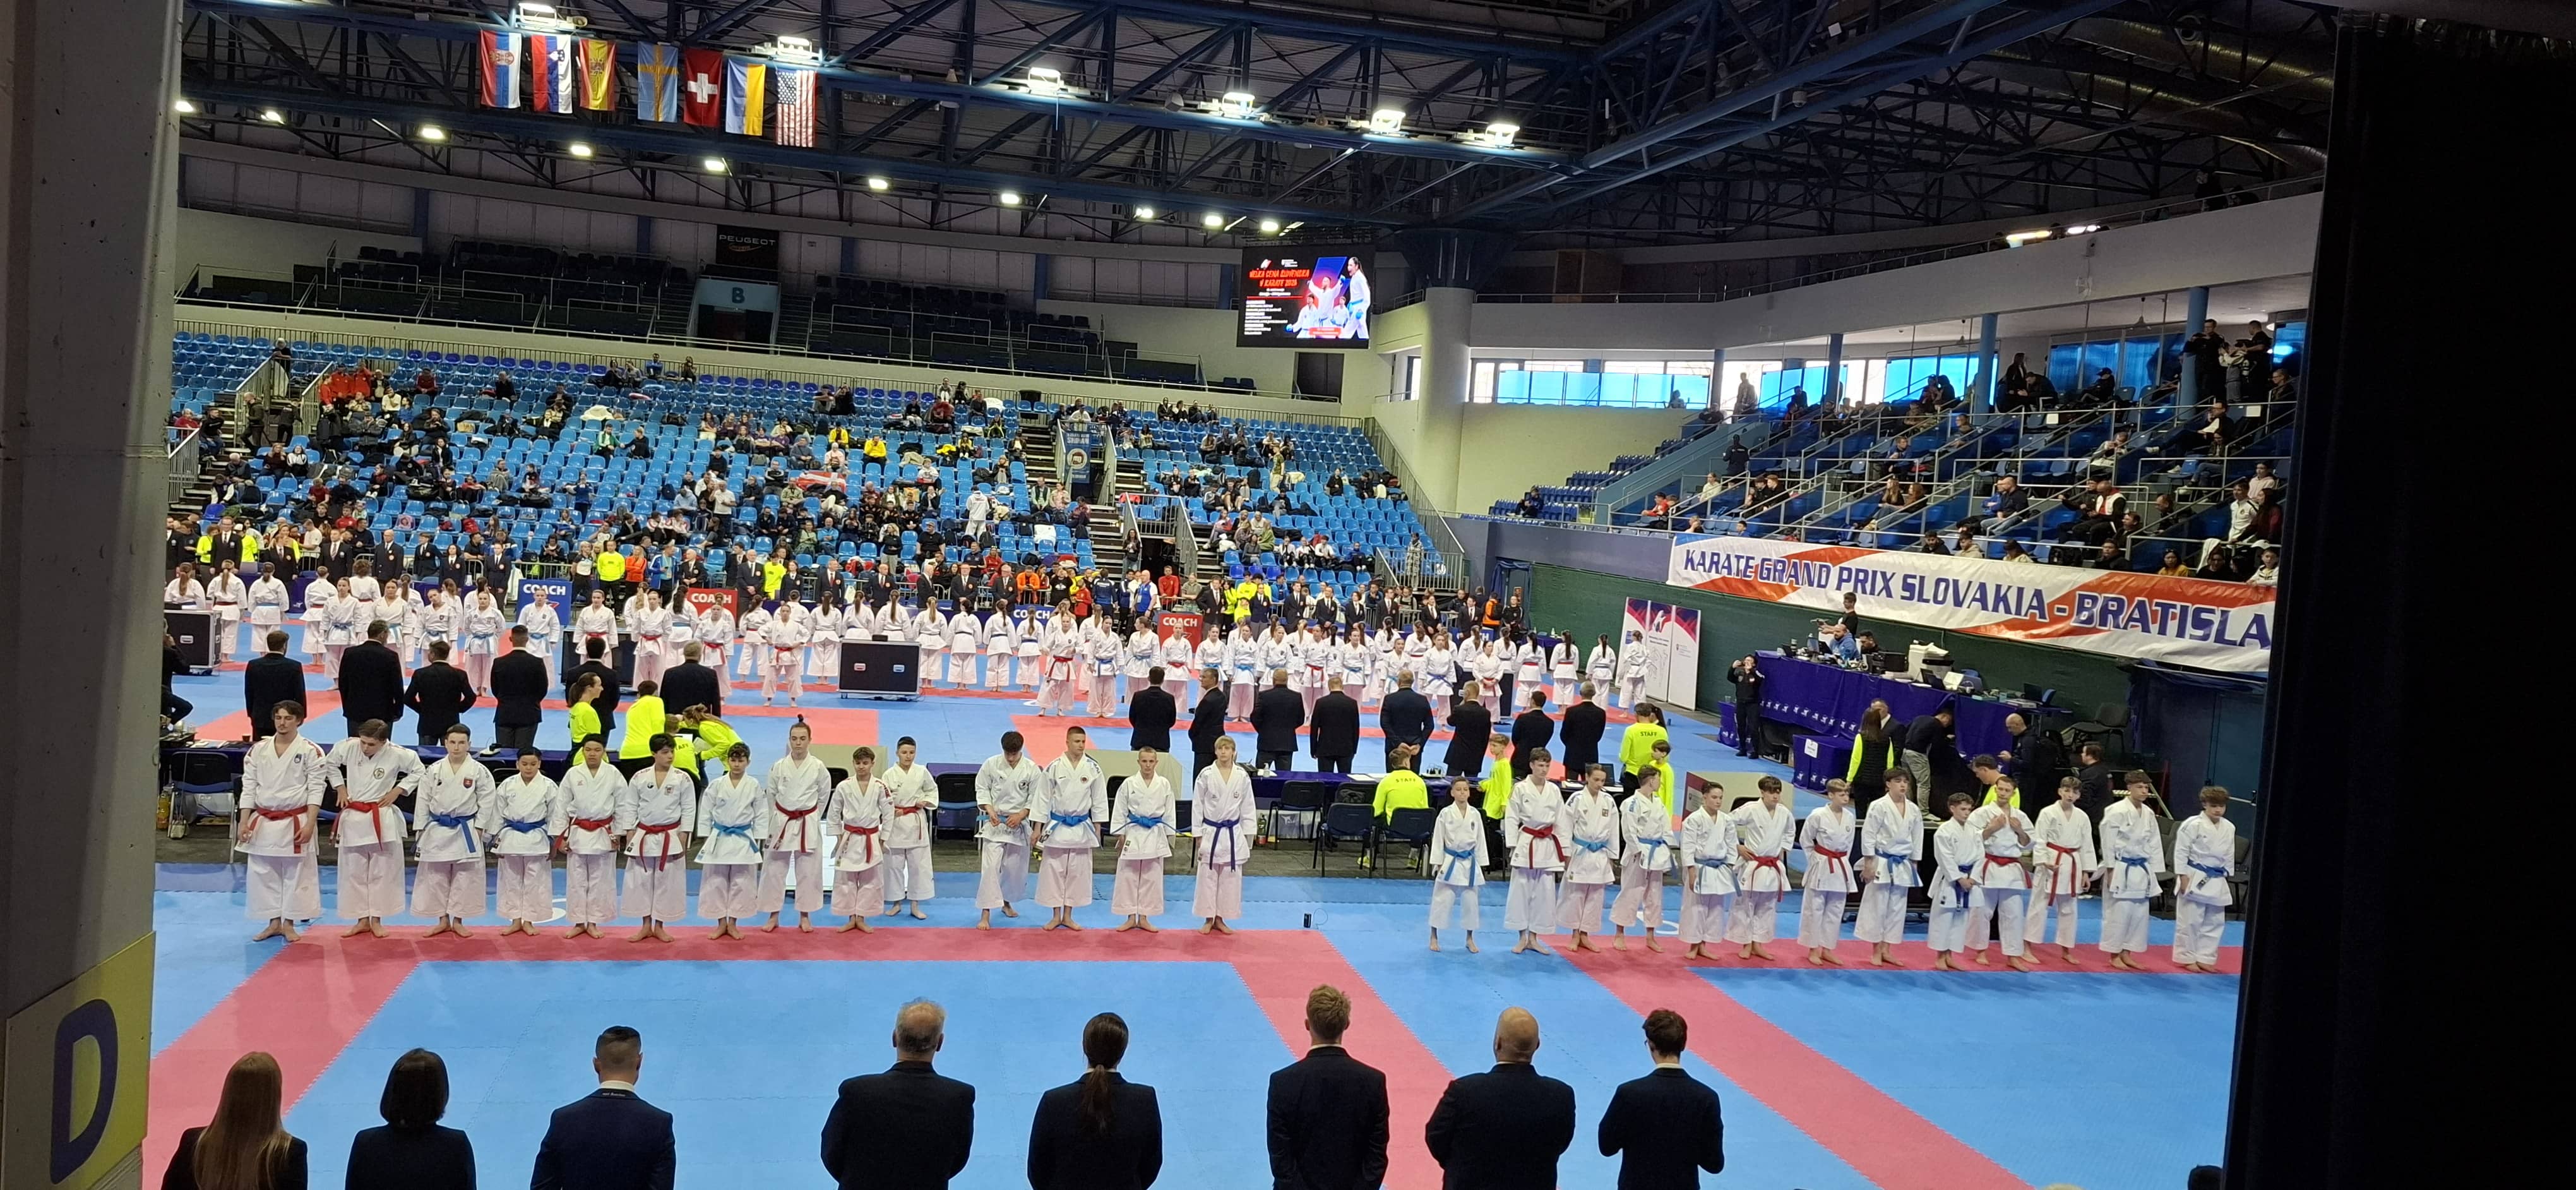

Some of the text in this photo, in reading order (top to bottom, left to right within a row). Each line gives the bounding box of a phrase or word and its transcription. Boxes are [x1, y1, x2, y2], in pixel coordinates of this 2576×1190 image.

[719, 234, 776, 246] PEUGEOT
[732, 287, 745, 303] B
[691, 593, 732, 604] COAH
[1684, 549, 1755, 579] KARATE
[1758, 558, 1832, 589] GRAND
[1836, 566, 1896, 598] PRIX
[1900, 574, 2048, 620] SLOVAKIA
[2073, 592, 2272, 649] BRATISLA
[1013, 609, 1051, 619] COCH
[50, 999, 118, 1185] D
